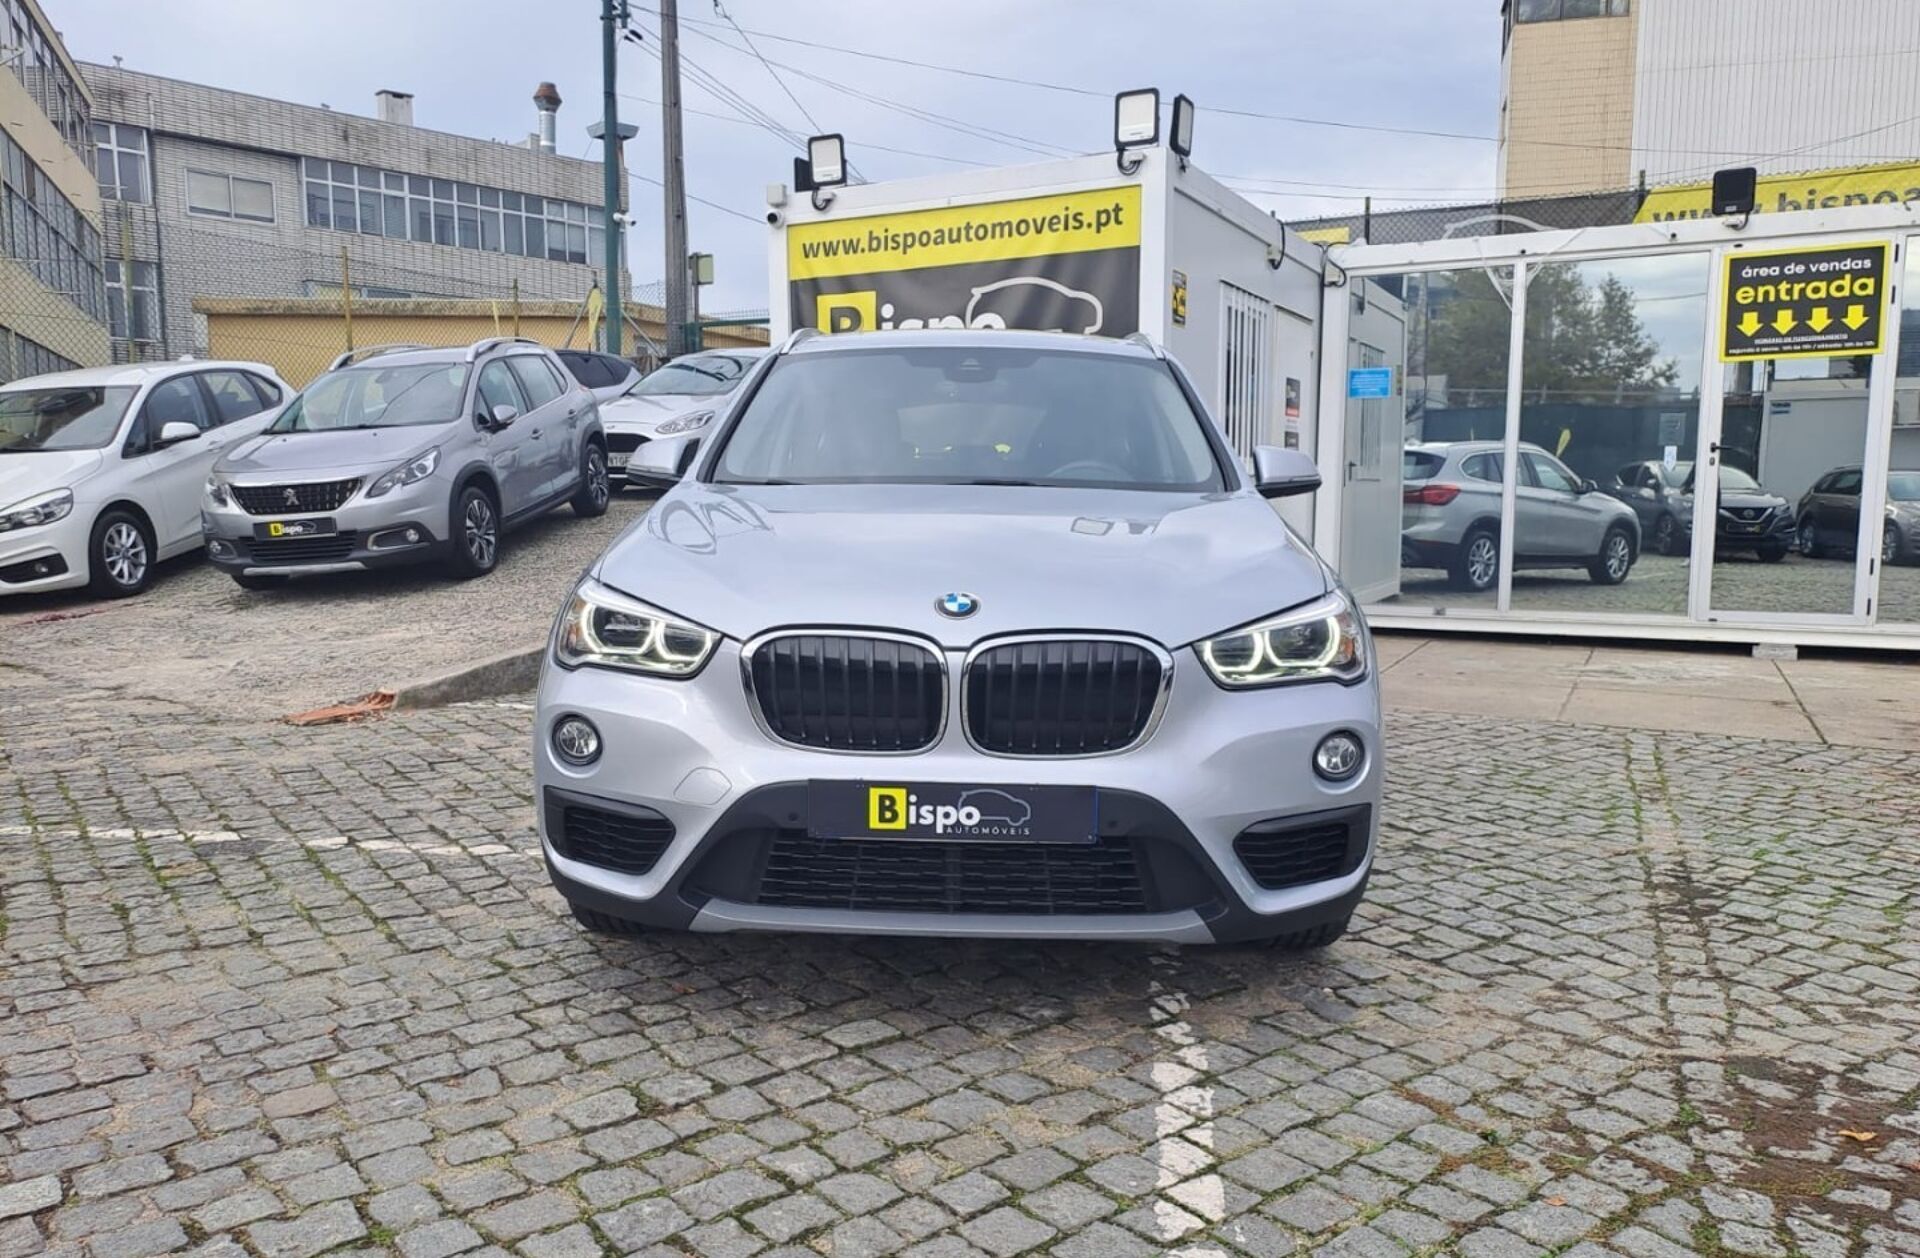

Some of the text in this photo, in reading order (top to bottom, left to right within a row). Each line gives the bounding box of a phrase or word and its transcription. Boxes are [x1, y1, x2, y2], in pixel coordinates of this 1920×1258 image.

[802, 203, 1124, 259] www.bispoautomoveis.pt
[1741, 258, 1872, 278] área de vendas
[1735, 273, 1876, 305] entrada
[876, 794, 981, 834] Bispo
[946, 825, 1031, 836] AUTOMÓVEIS
